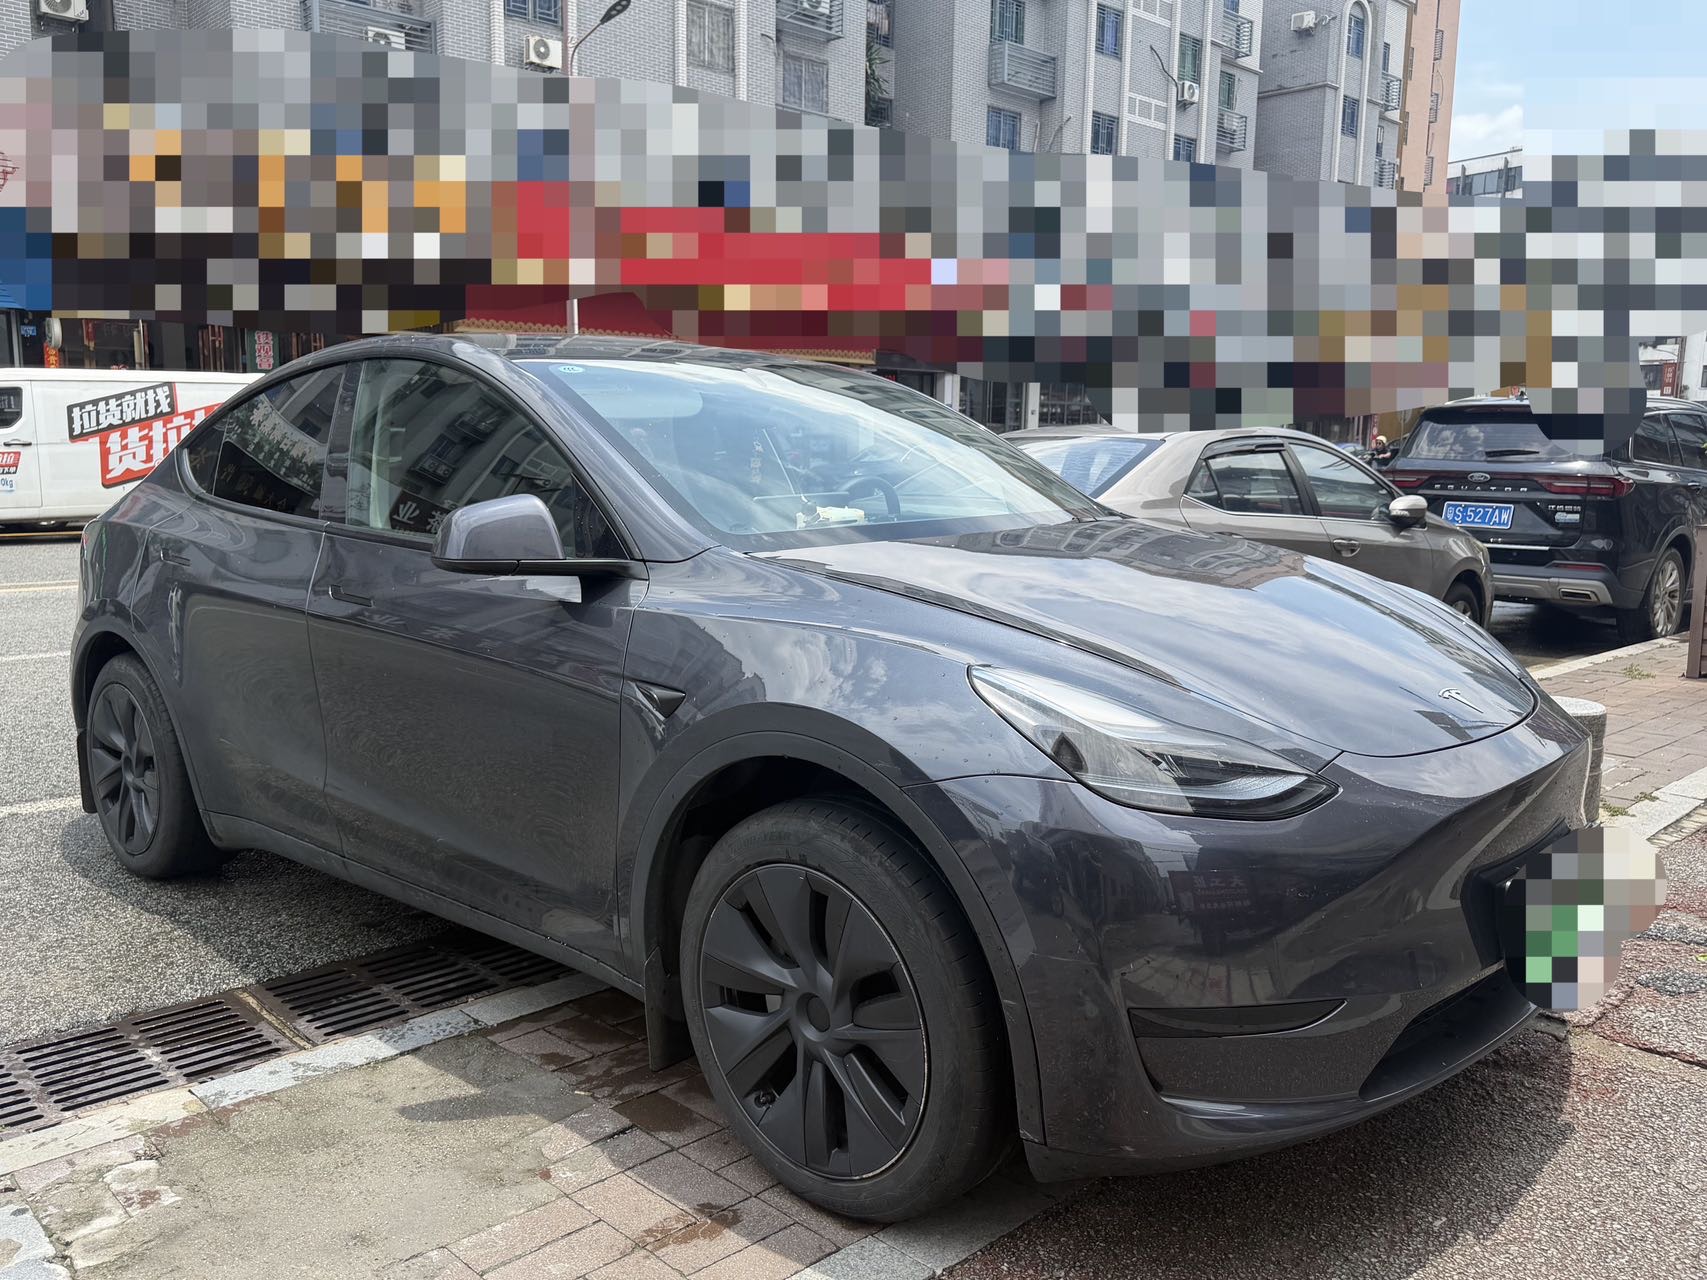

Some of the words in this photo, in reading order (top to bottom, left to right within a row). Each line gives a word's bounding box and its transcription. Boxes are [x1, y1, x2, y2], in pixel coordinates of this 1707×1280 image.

[72, 385, 171, 436] 拉货就找
[106, 408, 211, 479] 货拉
[1434, 484, 1528, 492] EQUATOR
